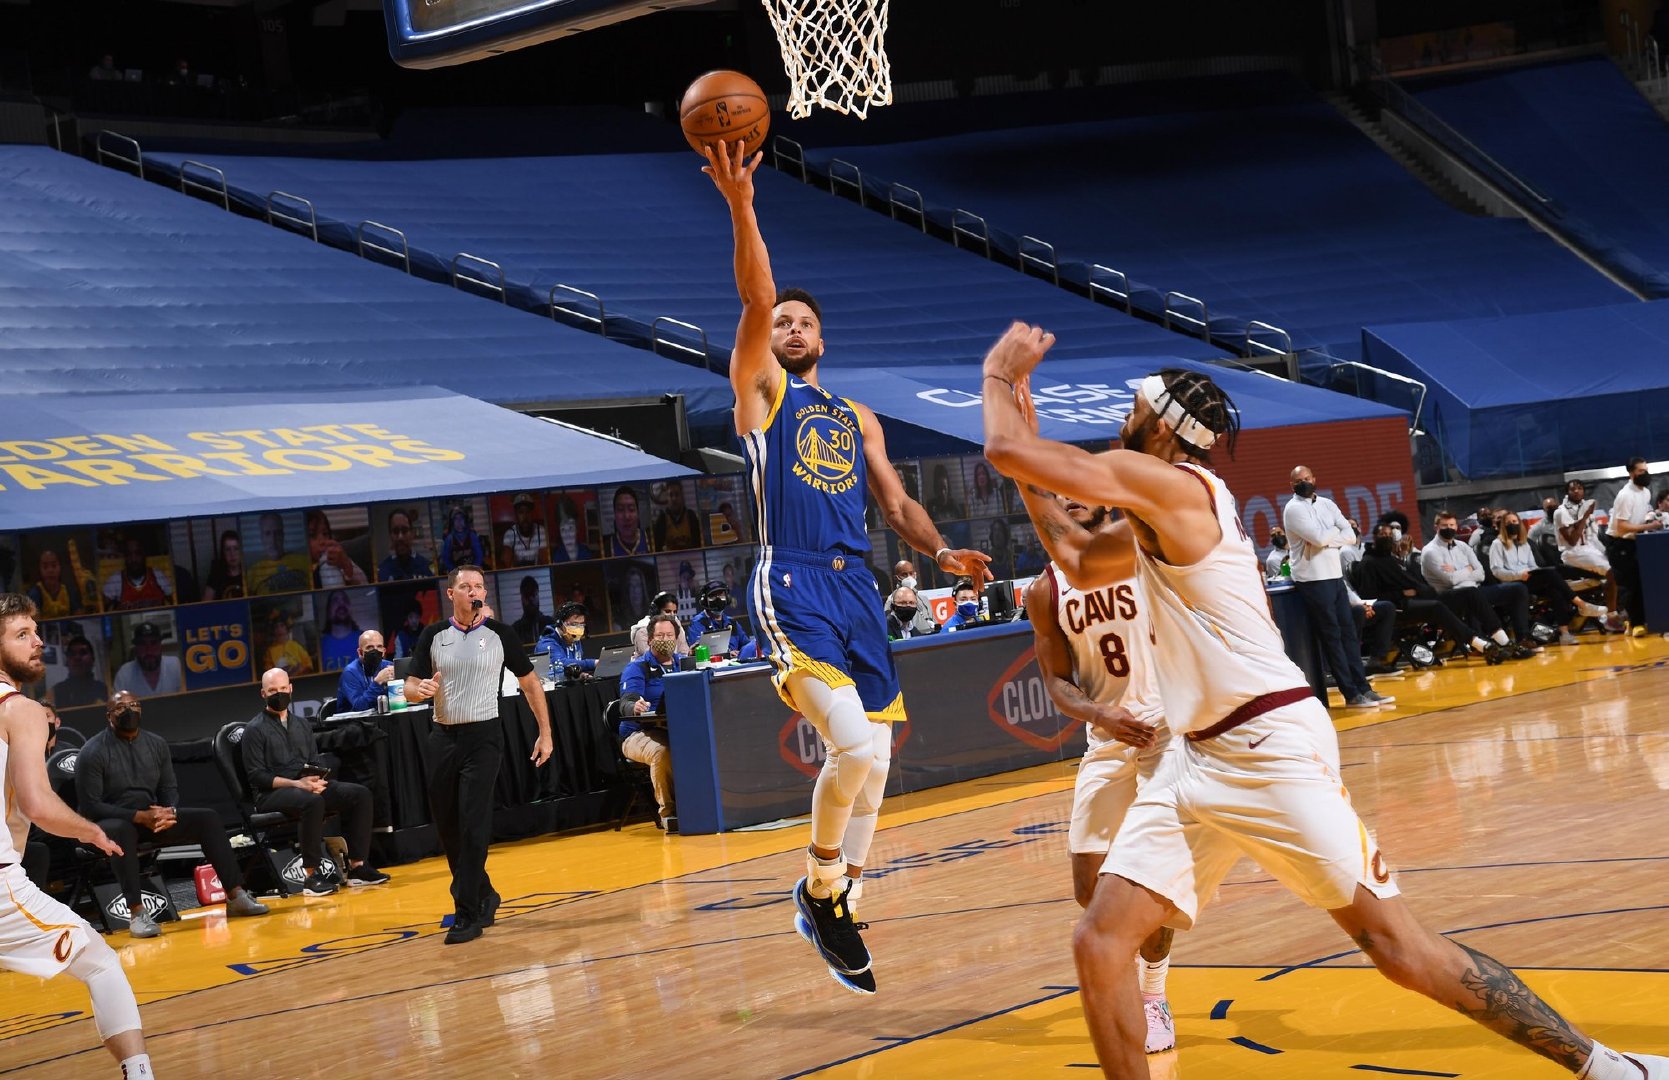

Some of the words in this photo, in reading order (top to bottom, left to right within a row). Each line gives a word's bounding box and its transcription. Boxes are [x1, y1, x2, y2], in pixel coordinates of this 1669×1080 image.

[796, 404, 828, 419] GOLDEN
[832, 408, 857, 432] STATE
[0, 433, 178, 461] DEN
[187, 424, 409, 450] STATE
[829, 429, 851, 450] 30
[0, 440, 465, 491] ARRIORS
[792, 462, 858, 495] WARRIORS
[936, 602, 948, 620] G
[1065, 584, 1138, 635] CAVS
[186, 624, 242, 643] LET'S
[186, 640, 248, 673] GO
[1099, 632, 1130, 678] 8
